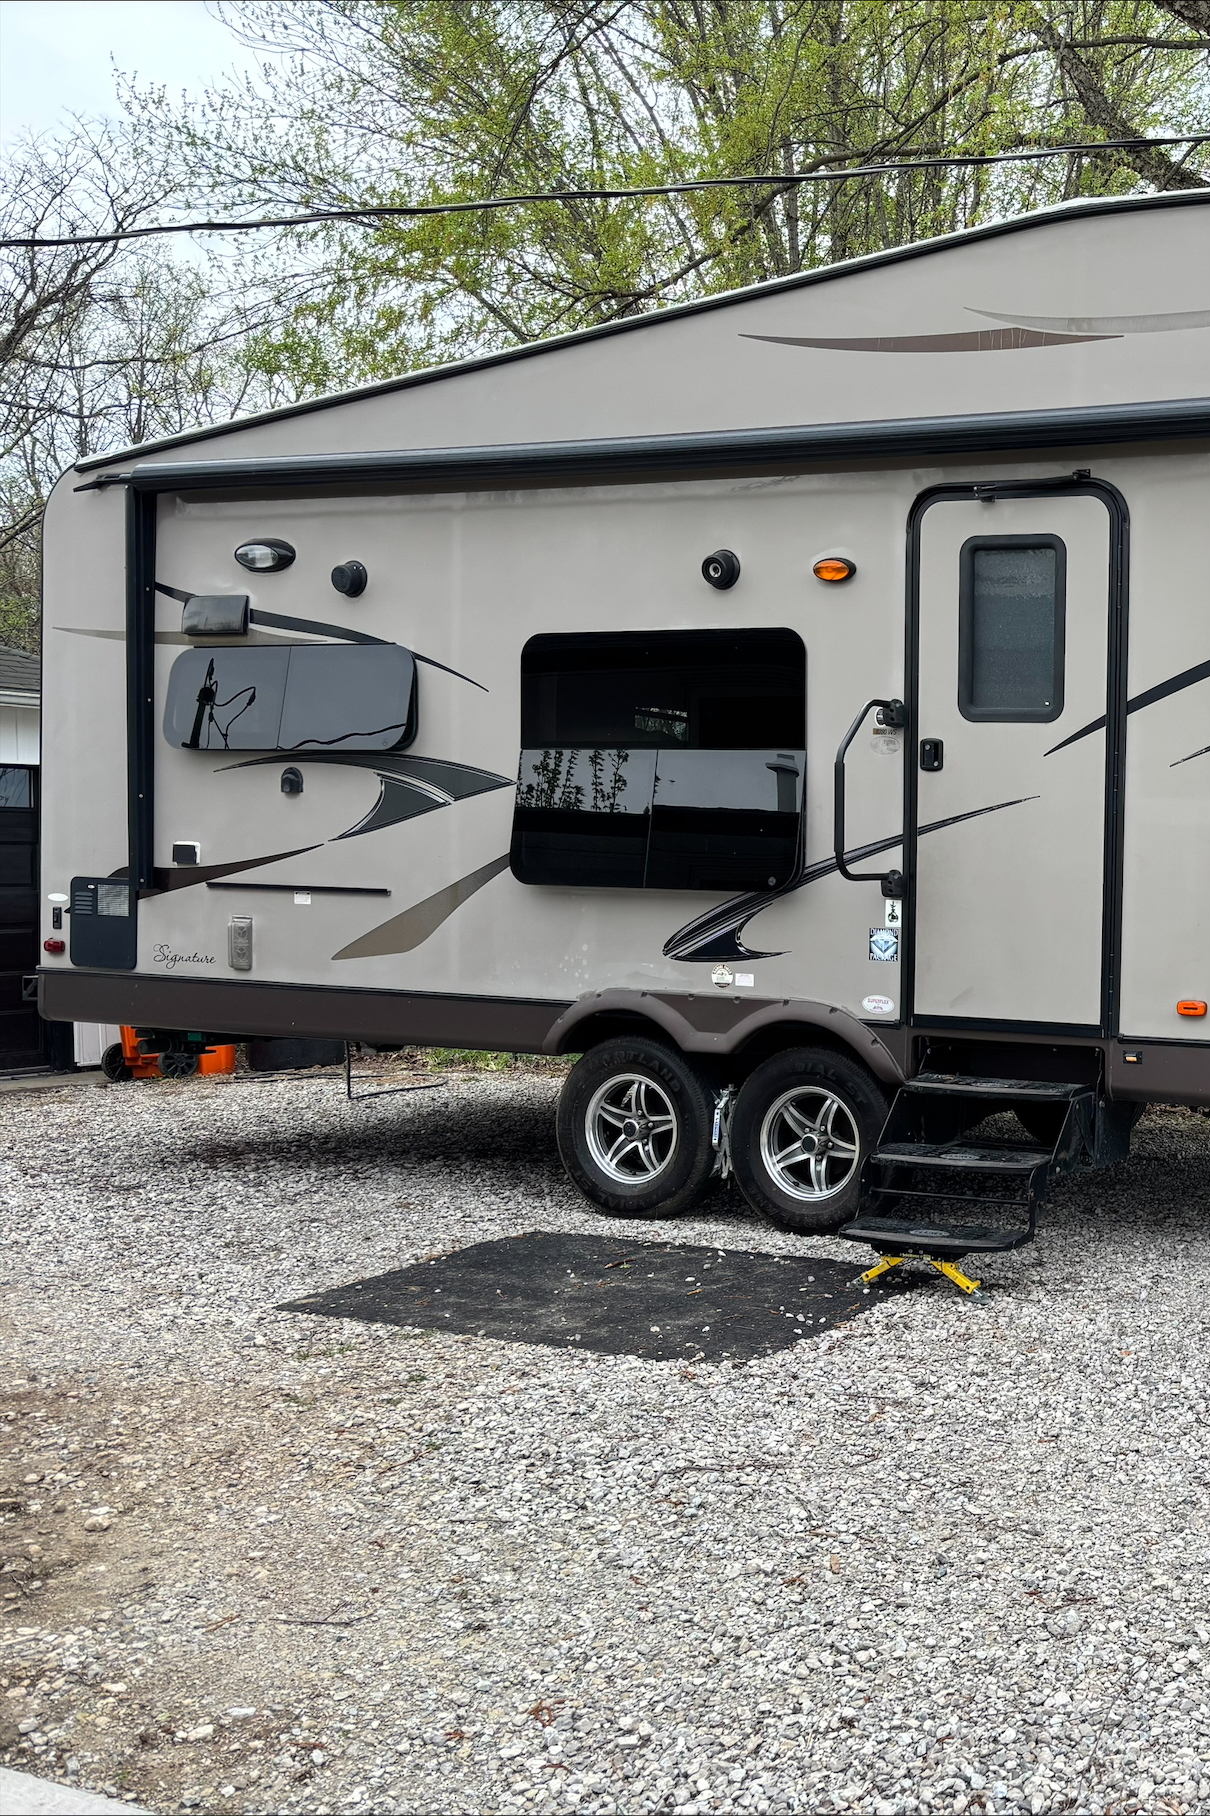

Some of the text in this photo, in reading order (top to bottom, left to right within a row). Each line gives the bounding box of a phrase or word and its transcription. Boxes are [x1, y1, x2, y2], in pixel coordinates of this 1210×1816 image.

[870, 928, 898, 936] DIAMOND
[153, 943, 216, 969] Signature
[869, 953, 898, 961] PACKAGE
